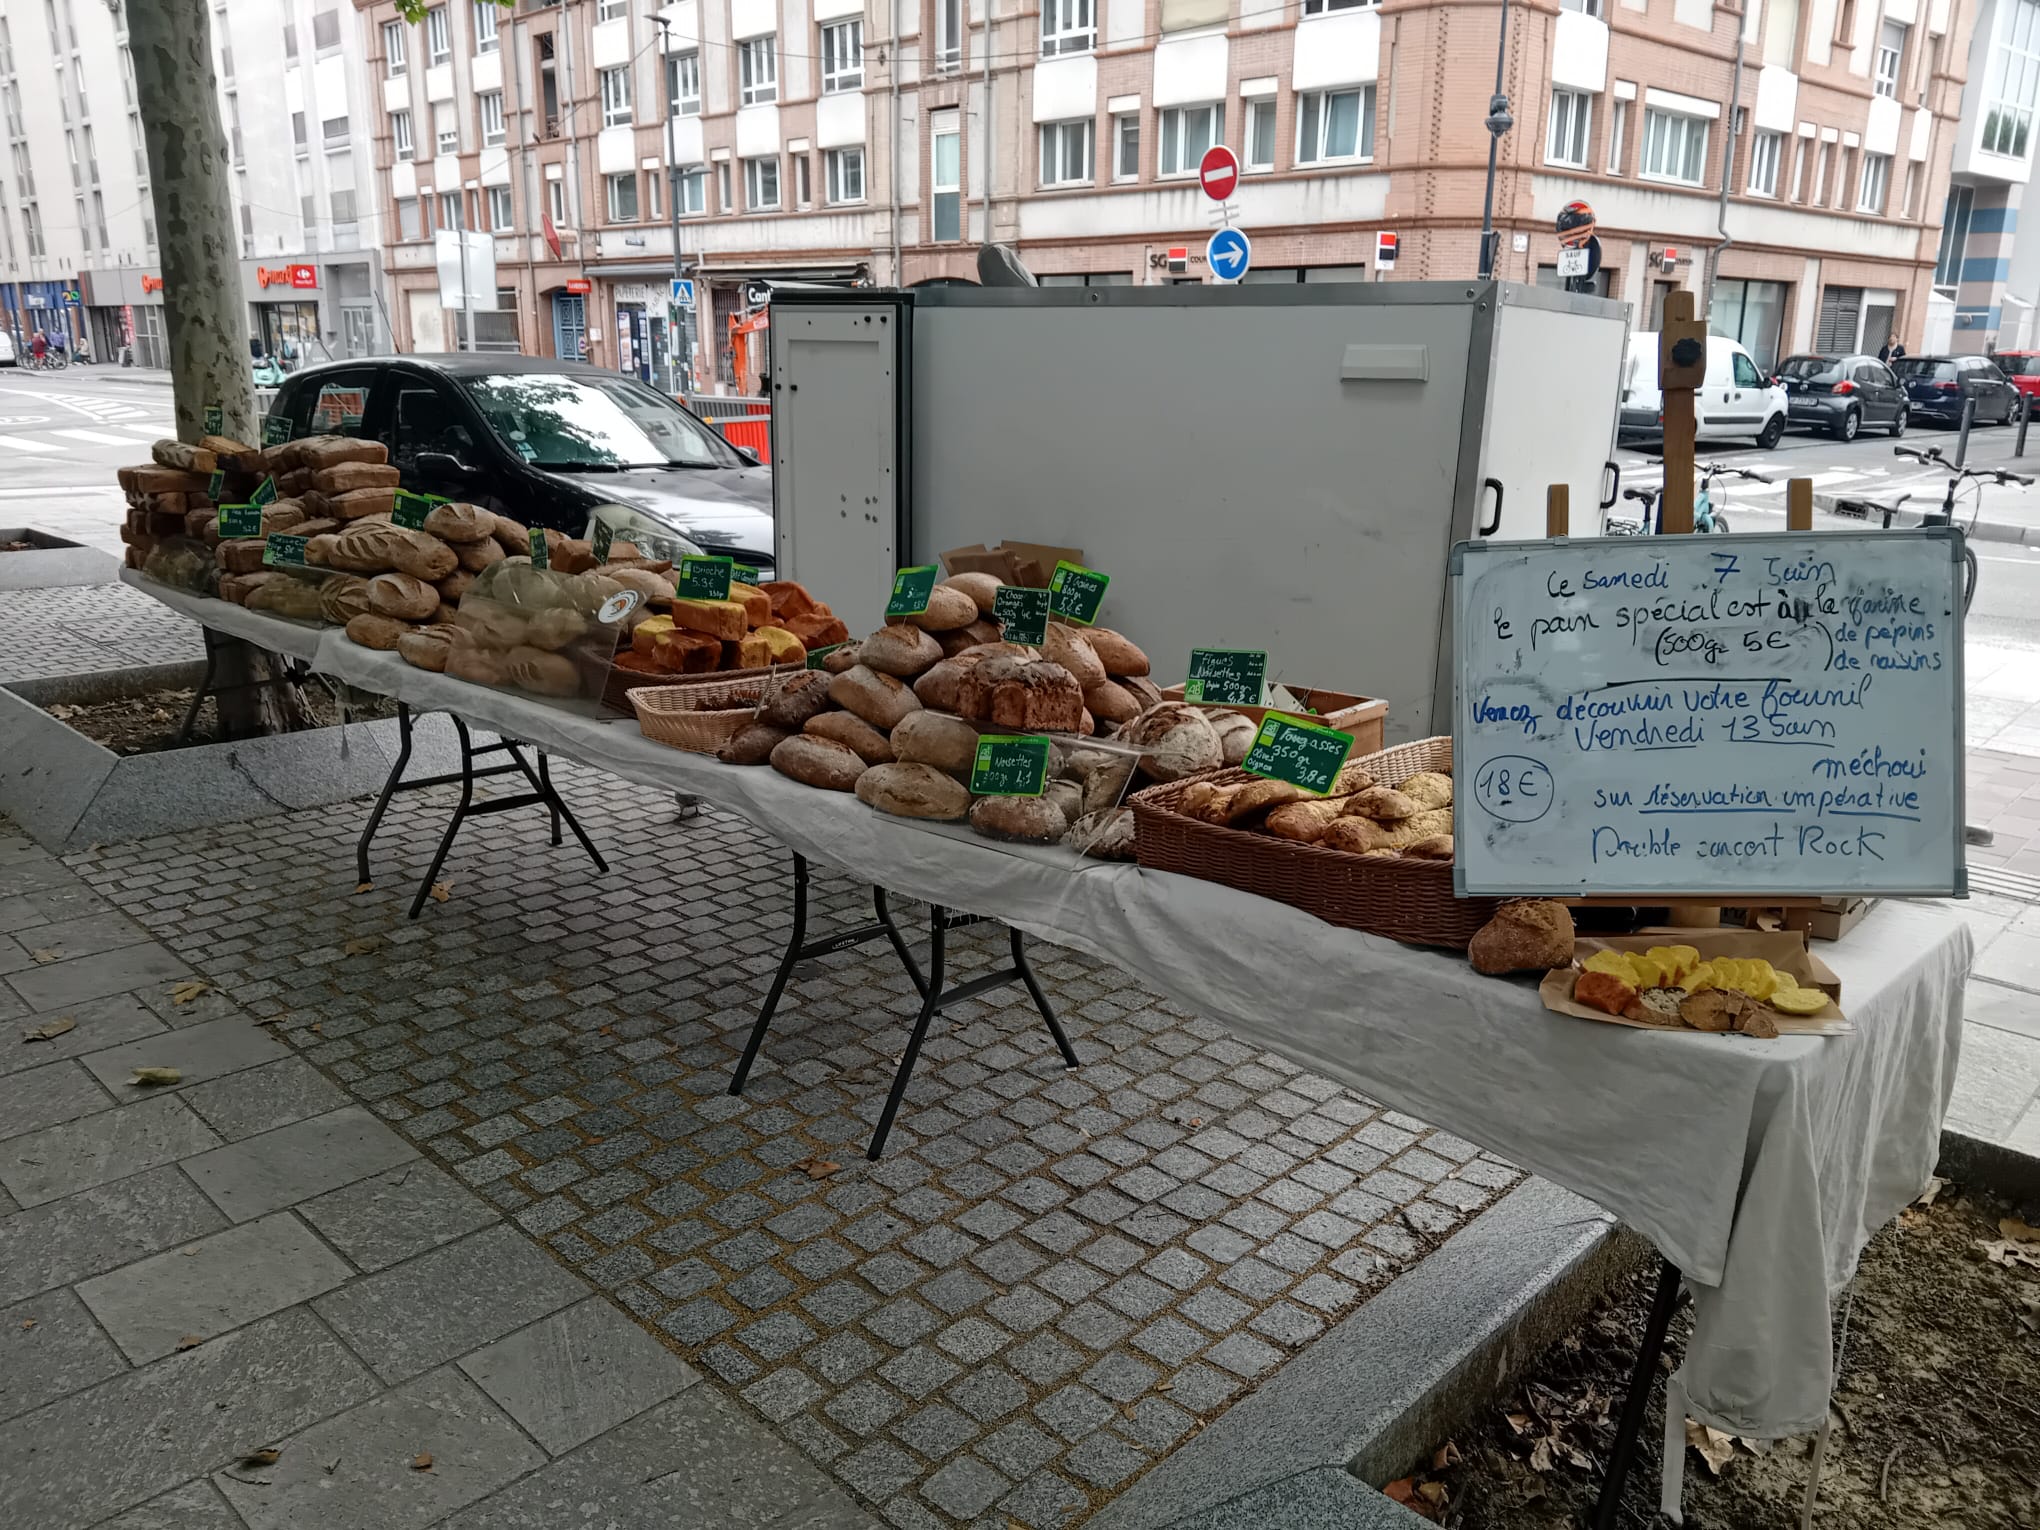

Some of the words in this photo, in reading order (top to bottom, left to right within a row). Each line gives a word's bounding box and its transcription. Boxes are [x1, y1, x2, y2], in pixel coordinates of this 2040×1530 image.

[1150, 254, 1167, 268] SG
[1710, 552, 1741, 583] 7
[1530, 616, 1600, 651] pain
[1726, 588, 1772, 617] est
[1834, 621, 1858, 643] de
[1833, 648, 1862, 671] de
[1721, 714, 1761, 743] 13
